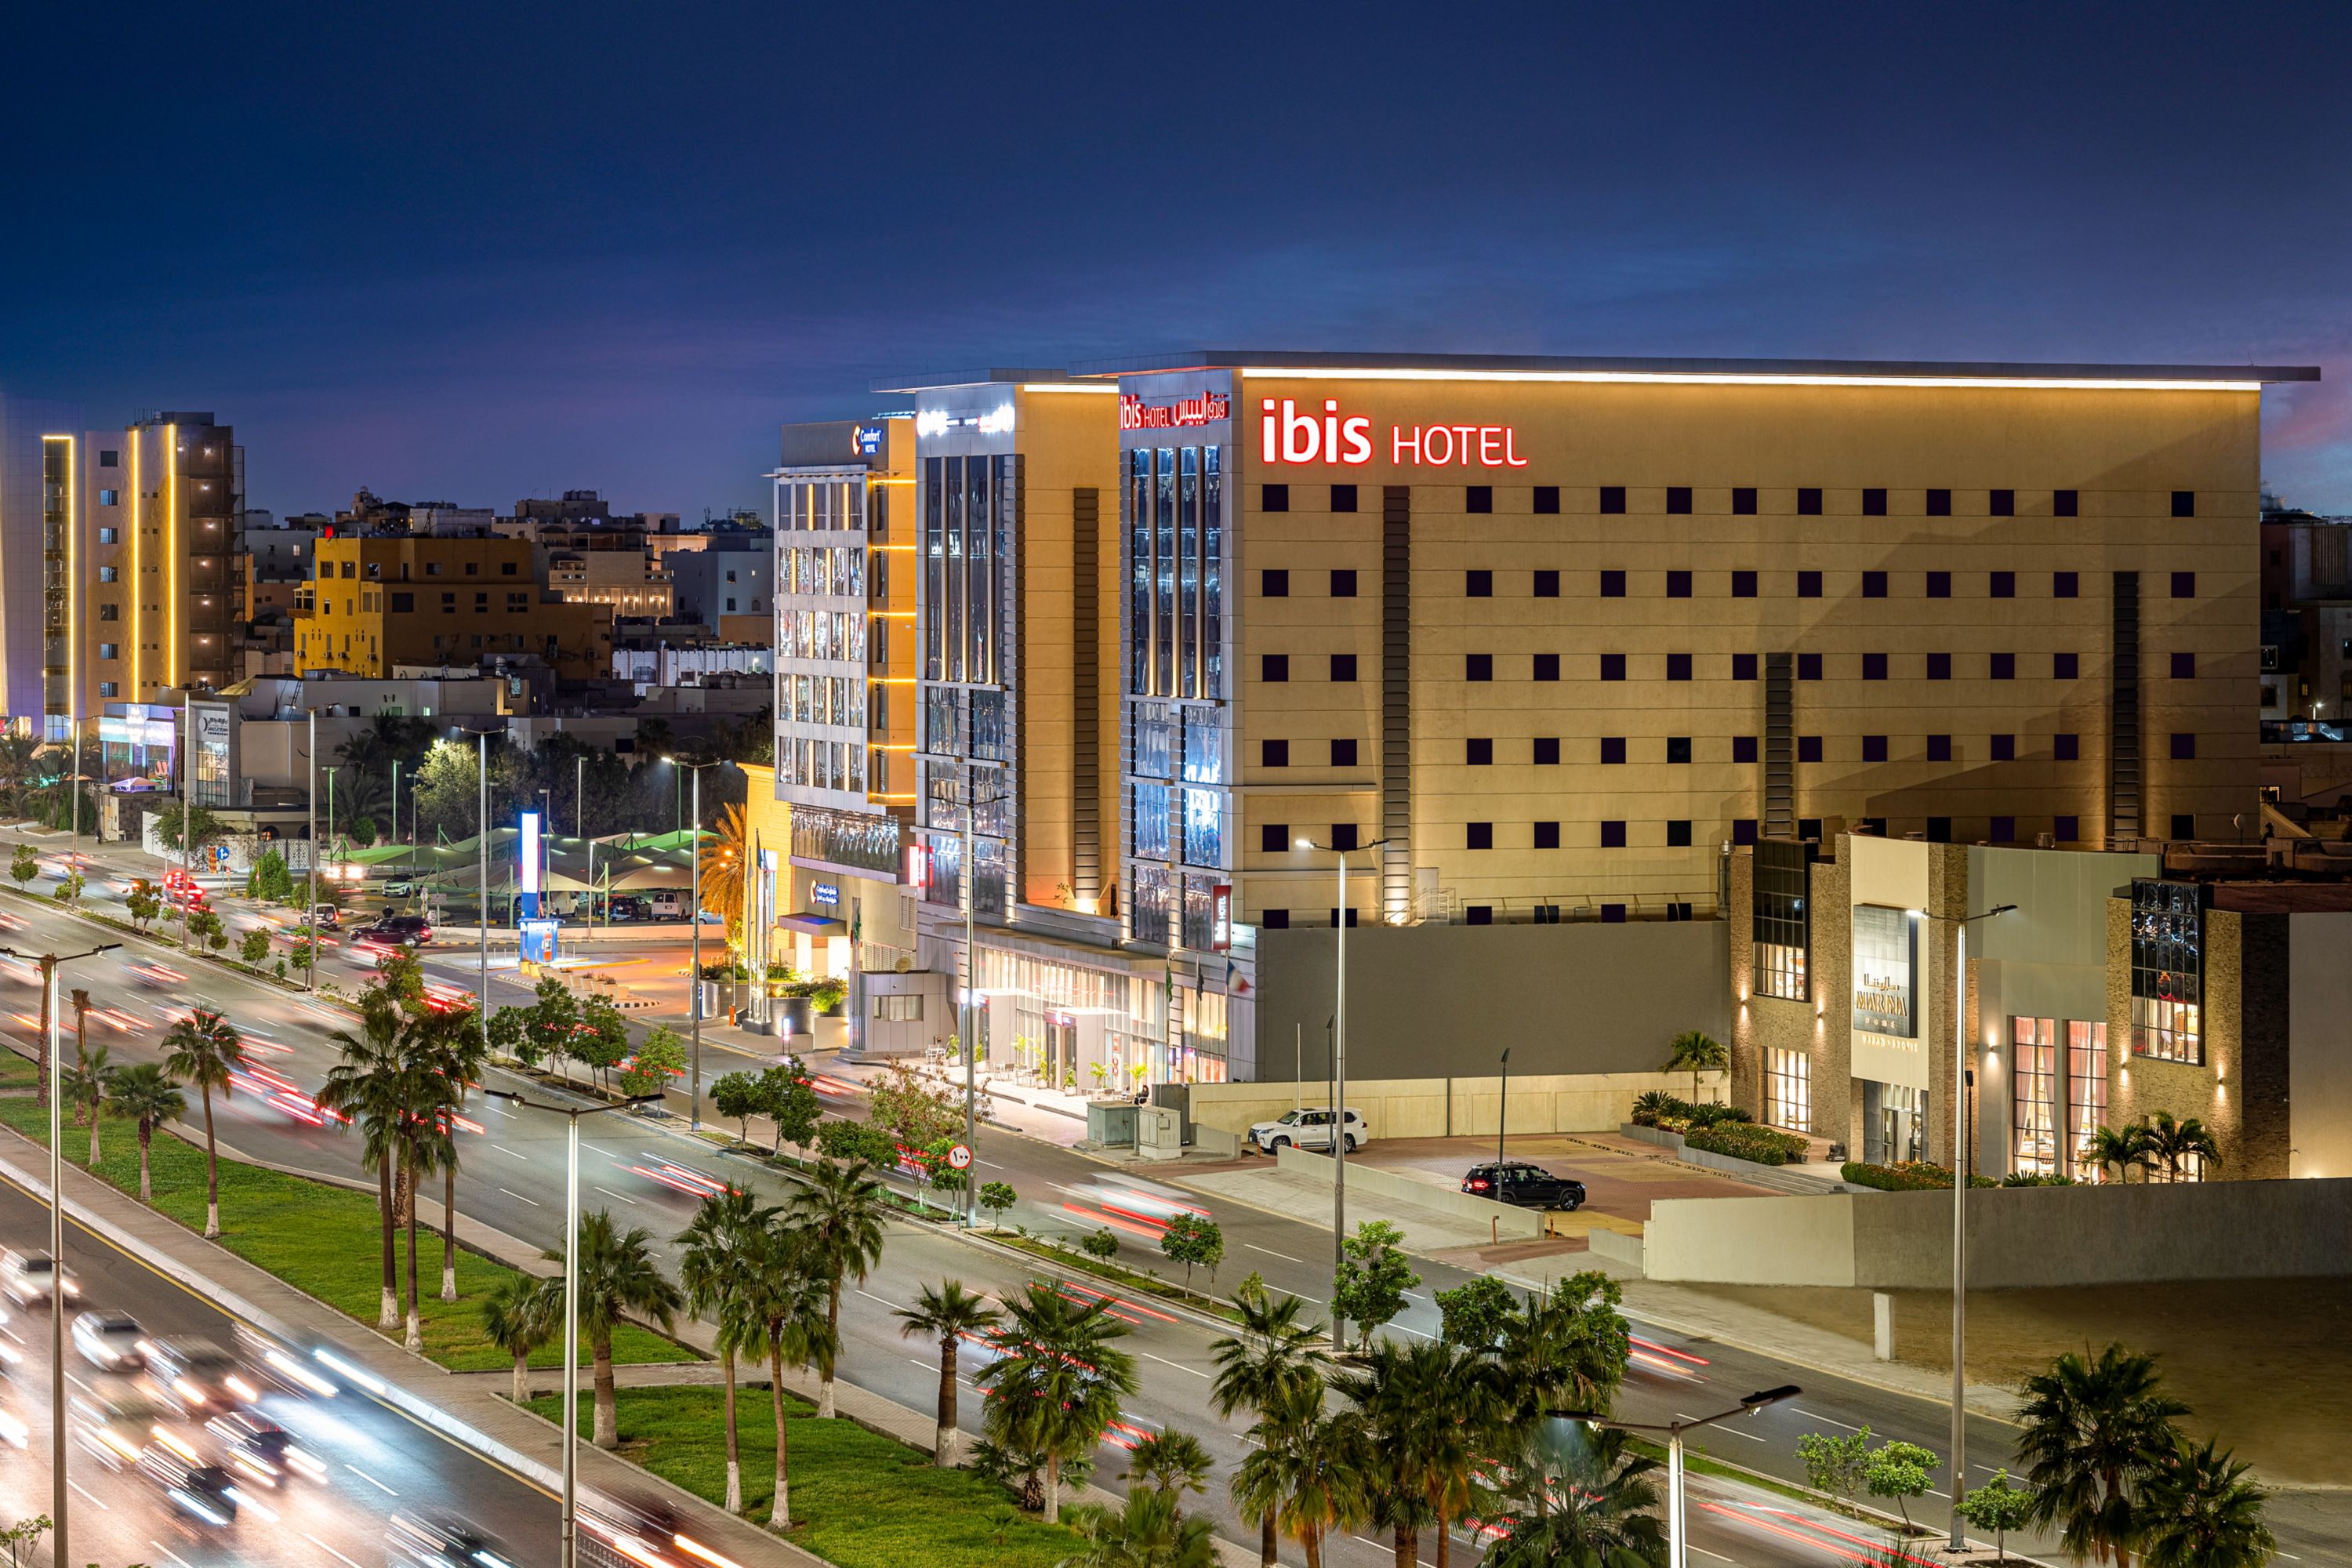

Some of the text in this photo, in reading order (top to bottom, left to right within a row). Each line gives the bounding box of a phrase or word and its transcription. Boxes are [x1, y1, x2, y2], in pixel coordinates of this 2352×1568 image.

[1120, 394, 1171, 430] ibis HOTEL
[860, 428, 880, 443] Comfort
[1261, 397, 1528, 466] ibis HOTEL
[1218, 895, 1227, 920] HOTEL
[1856, 990, 1907, 1017] MARINA
[1865, 1018, 1896, 1028] HOME
